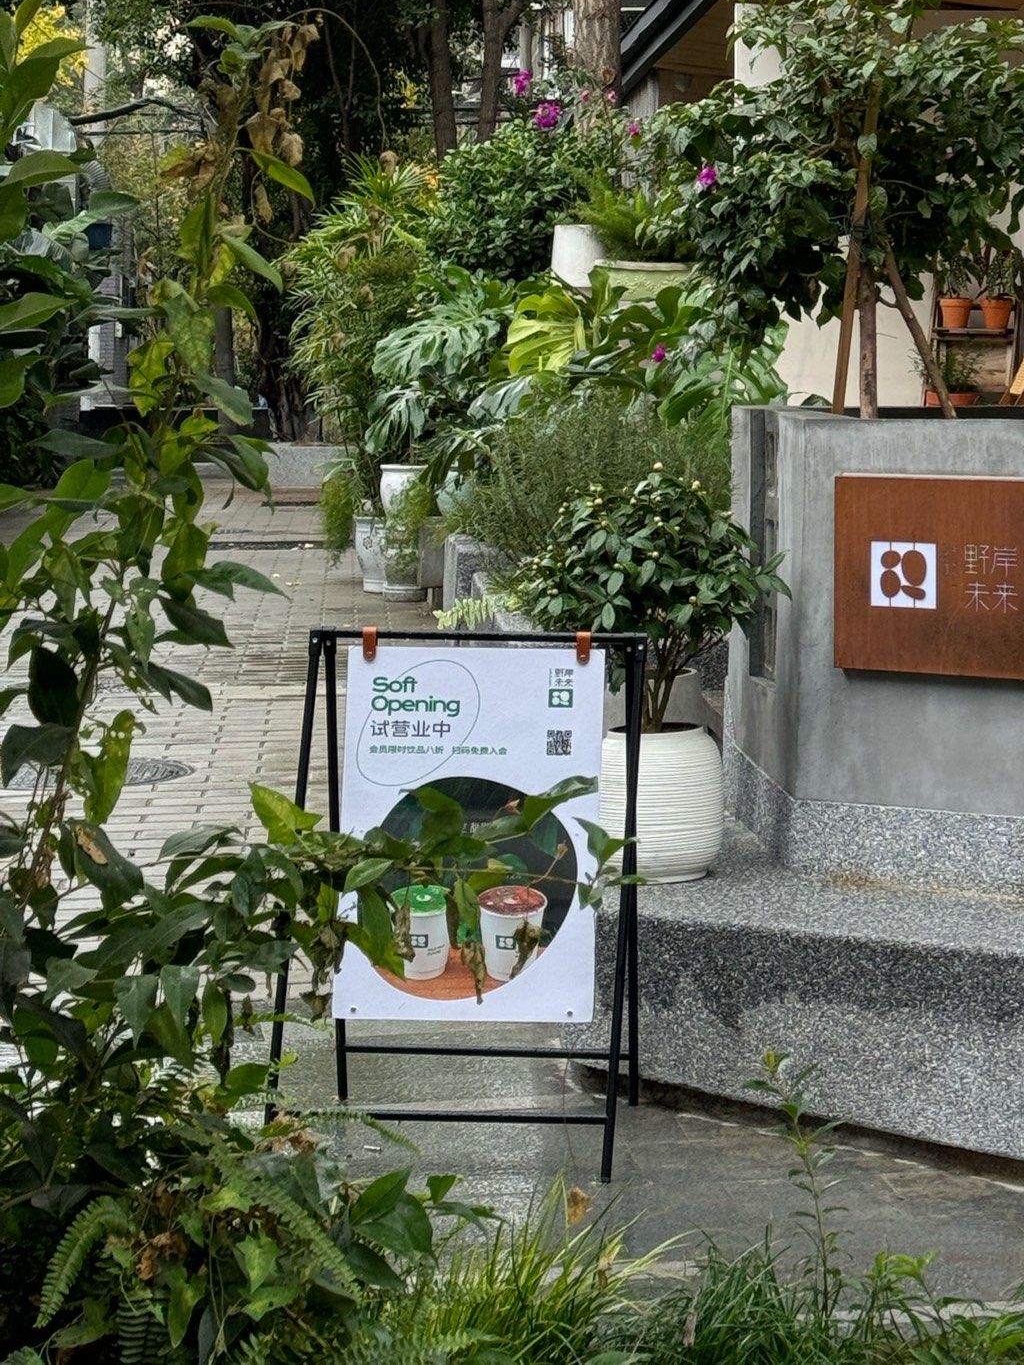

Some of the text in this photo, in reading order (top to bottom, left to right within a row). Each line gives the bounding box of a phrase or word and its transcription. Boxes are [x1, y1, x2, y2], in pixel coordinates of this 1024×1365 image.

[964, 544, 1018, 577] 野岸
[964, 581, 1019, 614] 未来
[372, 676, 418, 693] Soft
[371, 695, 460, 717] Opening
[370, 720, 451, 738] 试营业中
[369, 745, 508, 756] 会员限时饮品八折 扫码免费入会
